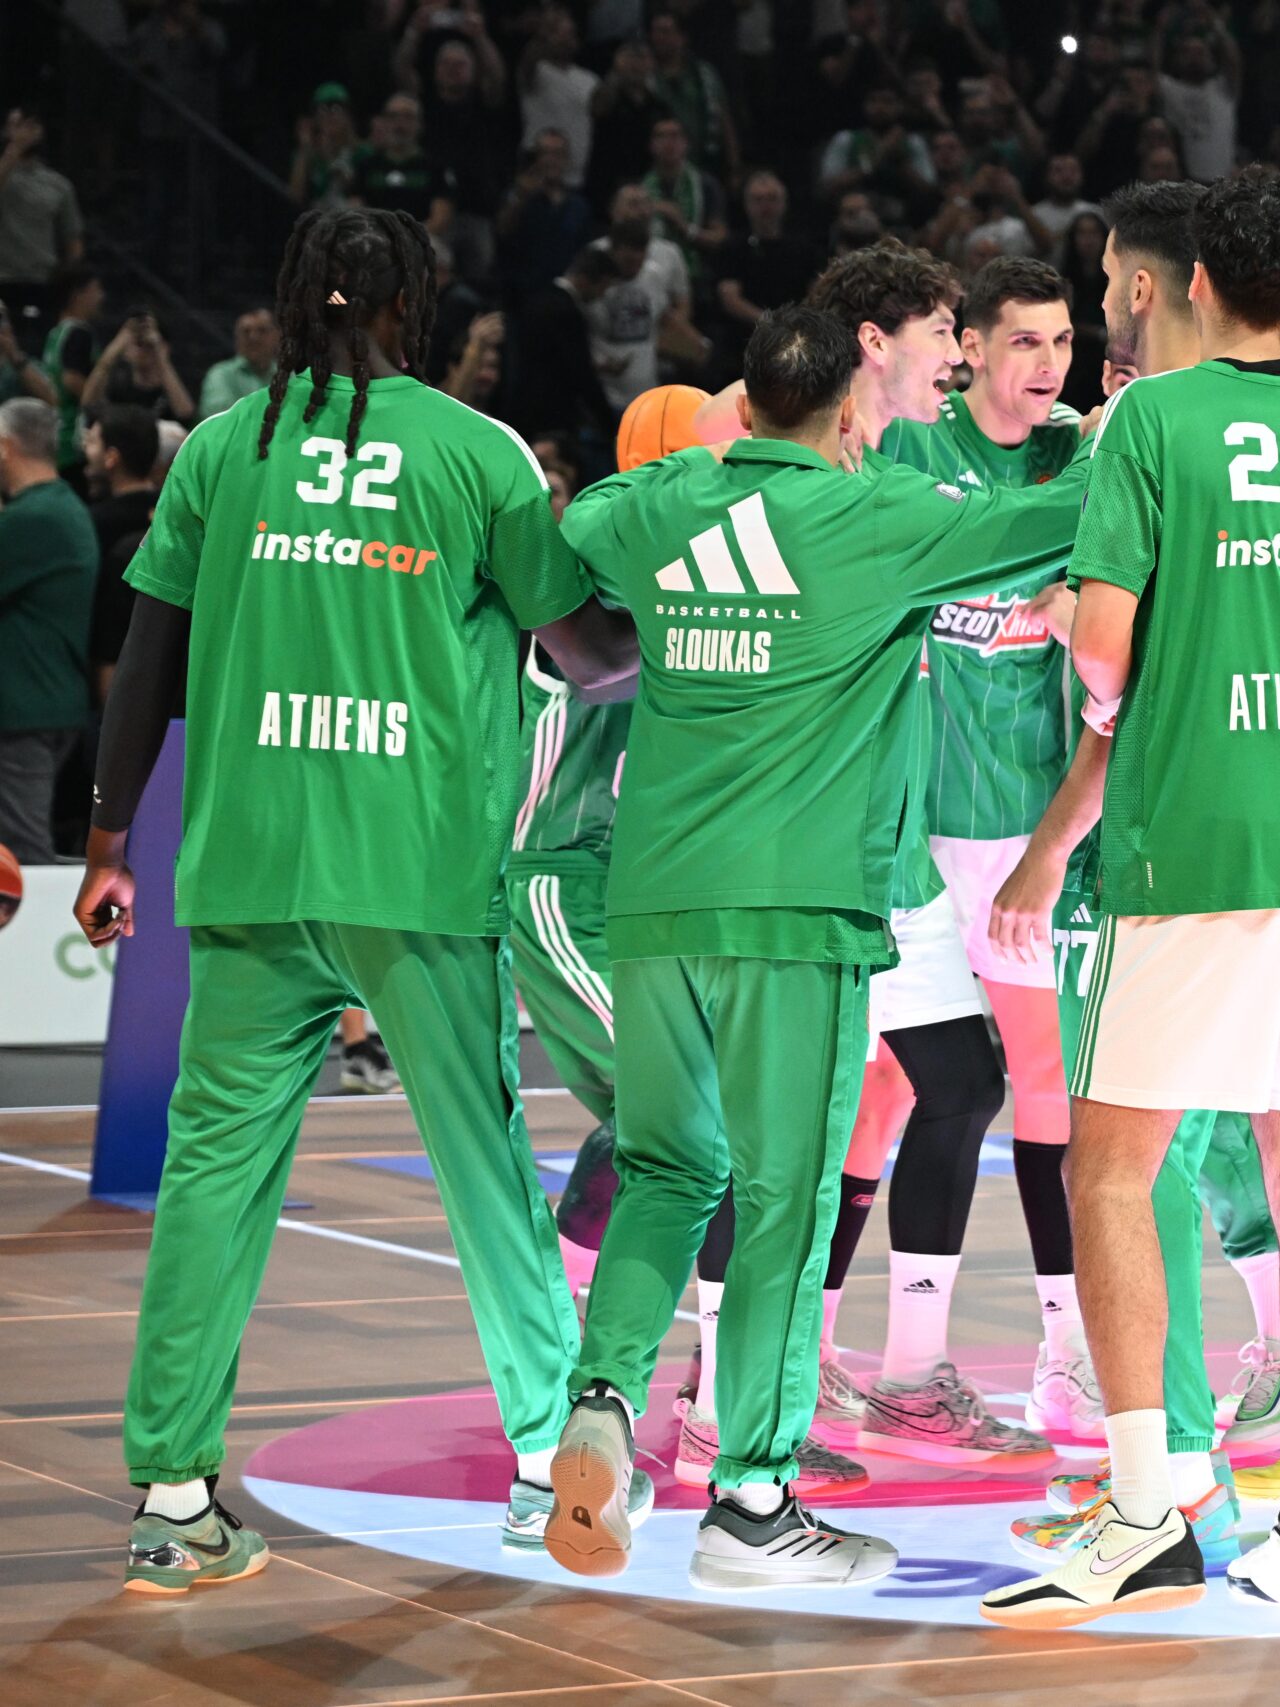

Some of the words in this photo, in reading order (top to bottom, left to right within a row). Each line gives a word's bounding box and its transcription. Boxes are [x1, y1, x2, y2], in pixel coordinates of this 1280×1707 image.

[296, 436, 403, 510] 32
[251, 521, 437, 576] instacar
[655, 604, 801, 620] BASKETBALL
[665, 627, 772, 673] SLOUKAS
[257, 691, 409, 757] ATHENS
[1053, 928, 1098, 997] 77
